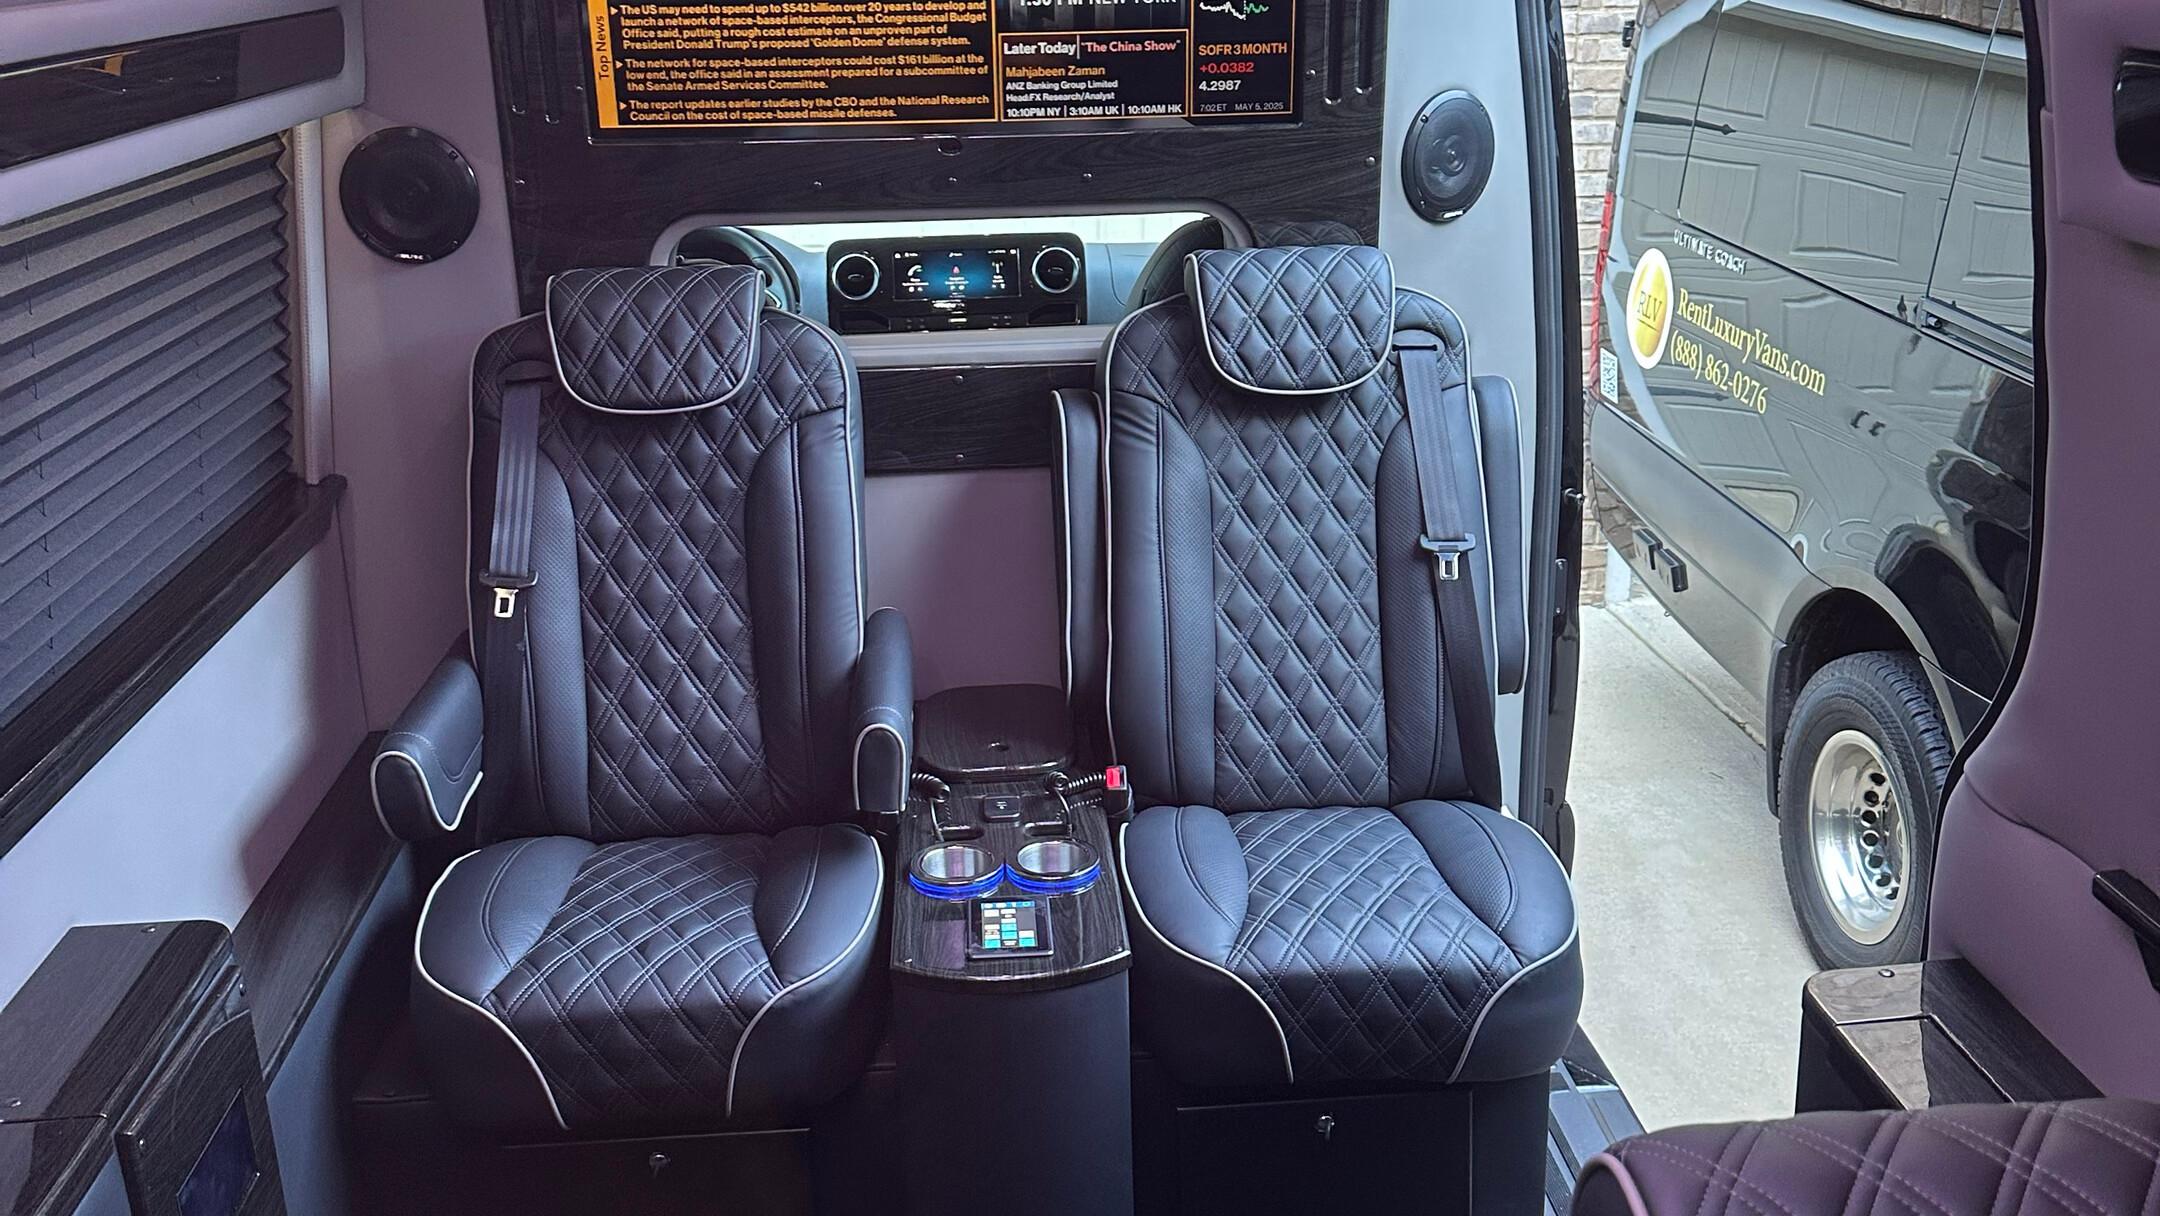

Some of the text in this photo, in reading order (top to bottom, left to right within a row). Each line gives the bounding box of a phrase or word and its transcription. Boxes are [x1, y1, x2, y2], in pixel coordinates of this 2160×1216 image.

[620, 5, 640, 14] The
[642, 5, 657, 14] US
[659, 6, 680, 16] may
[681, 4, 708, 14] need
[710, 4, 720, 14] to
[722, 4, 754, 15] spend
[756, 6, 768, 14] up
[770, 4, 781, 12] to
[782, 3, 810, 12] $542
[811, 2, 842, 12] billion
[868, 2, 881, 12] 20
[883, 3, 912, 12] years
[912, 2, 924, 10] to
[925, 1, 966, 12] develop
[967, 0, 986, 10] and
[621, 16, 656, 26] launch
[665, 16, 708, 26] network
[709, 16, 720, 25] of
[722, 15, 788, 26] space-based
[790, 14, 856, 25] interceptors,
[857, 14, 874, 24] the
[875, 13, 948, 24] Congressional
[950, 12, 986, 24] Budget
[622, 28, 656, 38] Office
[657, 28, 682, 38] said,
[683, 28, 721, 39] putting
[730, 27, 761, 38] rough
[762, 27, 786, 36] cost
[787, 26, 832, 36] estimate
[834, 28, 848, 36] on
[849, 27, 862, 35] an
[863, 26, 912, 36] unproven
[914, 25, 936, 36] part
[936, 24, 948, 34] of
[594, 16, 611, 80] Top News
[623, 40, 674, 50] President
[676, 40, 713, 48] Donald
[714, 39, 758, 50] Trump's
[759, 38, 810, 50] proposed
[887, 36, 929, 46] defense
[930, 36, 971, 47] system.
[1003, 42, 1076, 56] Later Today
[1109, 41, 1142, 52] China
[1198, 42, 1288, 56] SOFR 3 MONTH
[624, 54, 984, 68] The network for space-based interceptors could cost $161 billion at the
[1200, 62, 1255, 74] +0.0382
[626, 65, 988, 80] low end, the office said in an assessment prepared for a subcommittee of
[1005, 66, 1106, 78] Mahjabeen Zaman
[627, 80, 828, 91] the Senate Armed Services Committee.
[1006, 80, 1118, 91] ANZ Banking Group Limited
[1199, 80, 1242, 91] 4.2987
[629, 94, 990, 110] The report updates earlier studies by the CBO and the National Research
[1128, 104, 1182, 114] 10:10AM HK
[1235, 102, 1254, 111] MAY
[1264, 102, 1284, 110] 2025
[630, 112, 670, 120] Council
[686, 111, 704, 120] the
[705, 111, 728, 120] cost
[730, 110, 740, 120] of
[742, 110, 809, 121] space-based
[810, 108, 846, 118] missile
[846, 108, 898, 118] defenses.
[1007, 107, 1062, 116] 10:10PM NY
[1069, 106, 1120, 116] 3:10AM UK
[1674, 228, 1747, 275] ULTIMATE COACH
[1637, 290, 1662, 322] RLV
[1676, 288, 1826, 396] RentLuxuryVans.com
[1670, 330, 1769, 415] (888) 862-0276
